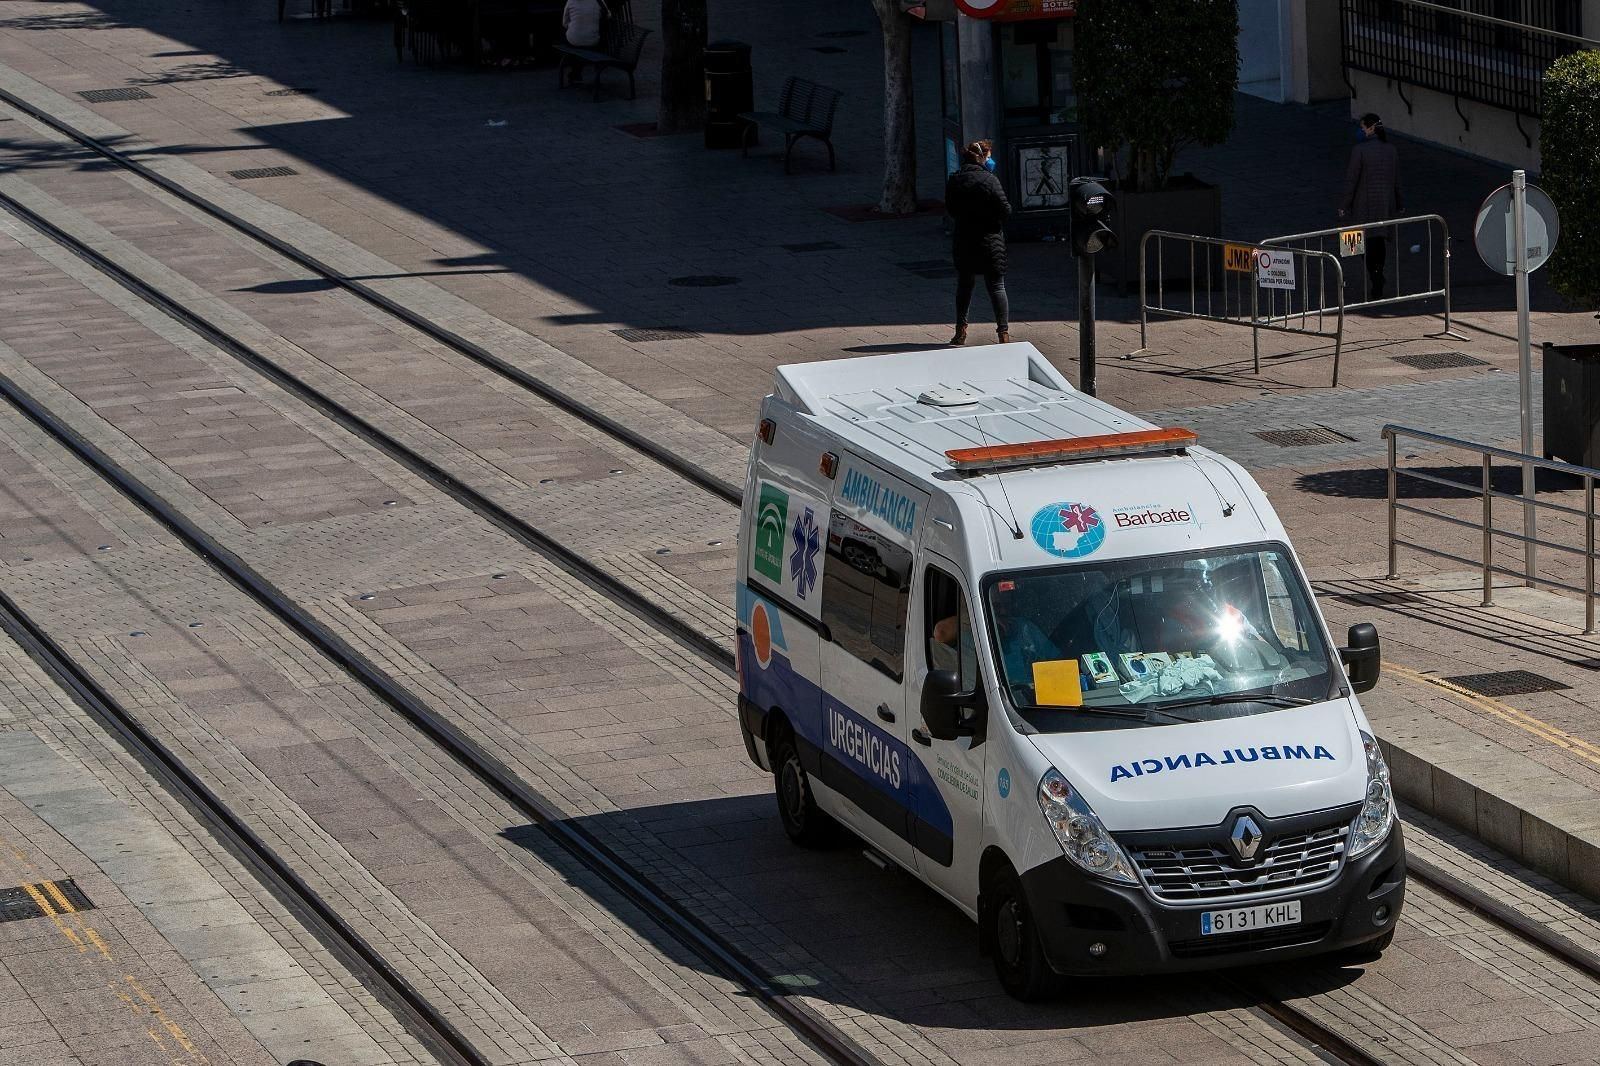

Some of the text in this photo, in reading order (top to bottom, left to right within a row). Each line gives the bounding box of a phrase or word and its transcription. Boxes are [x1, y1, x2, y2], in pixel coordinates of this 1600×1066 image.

[1228, 248, 1249, 269] JMR
[842, 467, 916, 535] AMBULANCIA
[1114, 508, 1190, 527] Barbate
[829, 707, 900, 789] URGENCIAS
[1214, 909, 1256, 930] 6131
[1265, 905, 1297, 924] KHL
